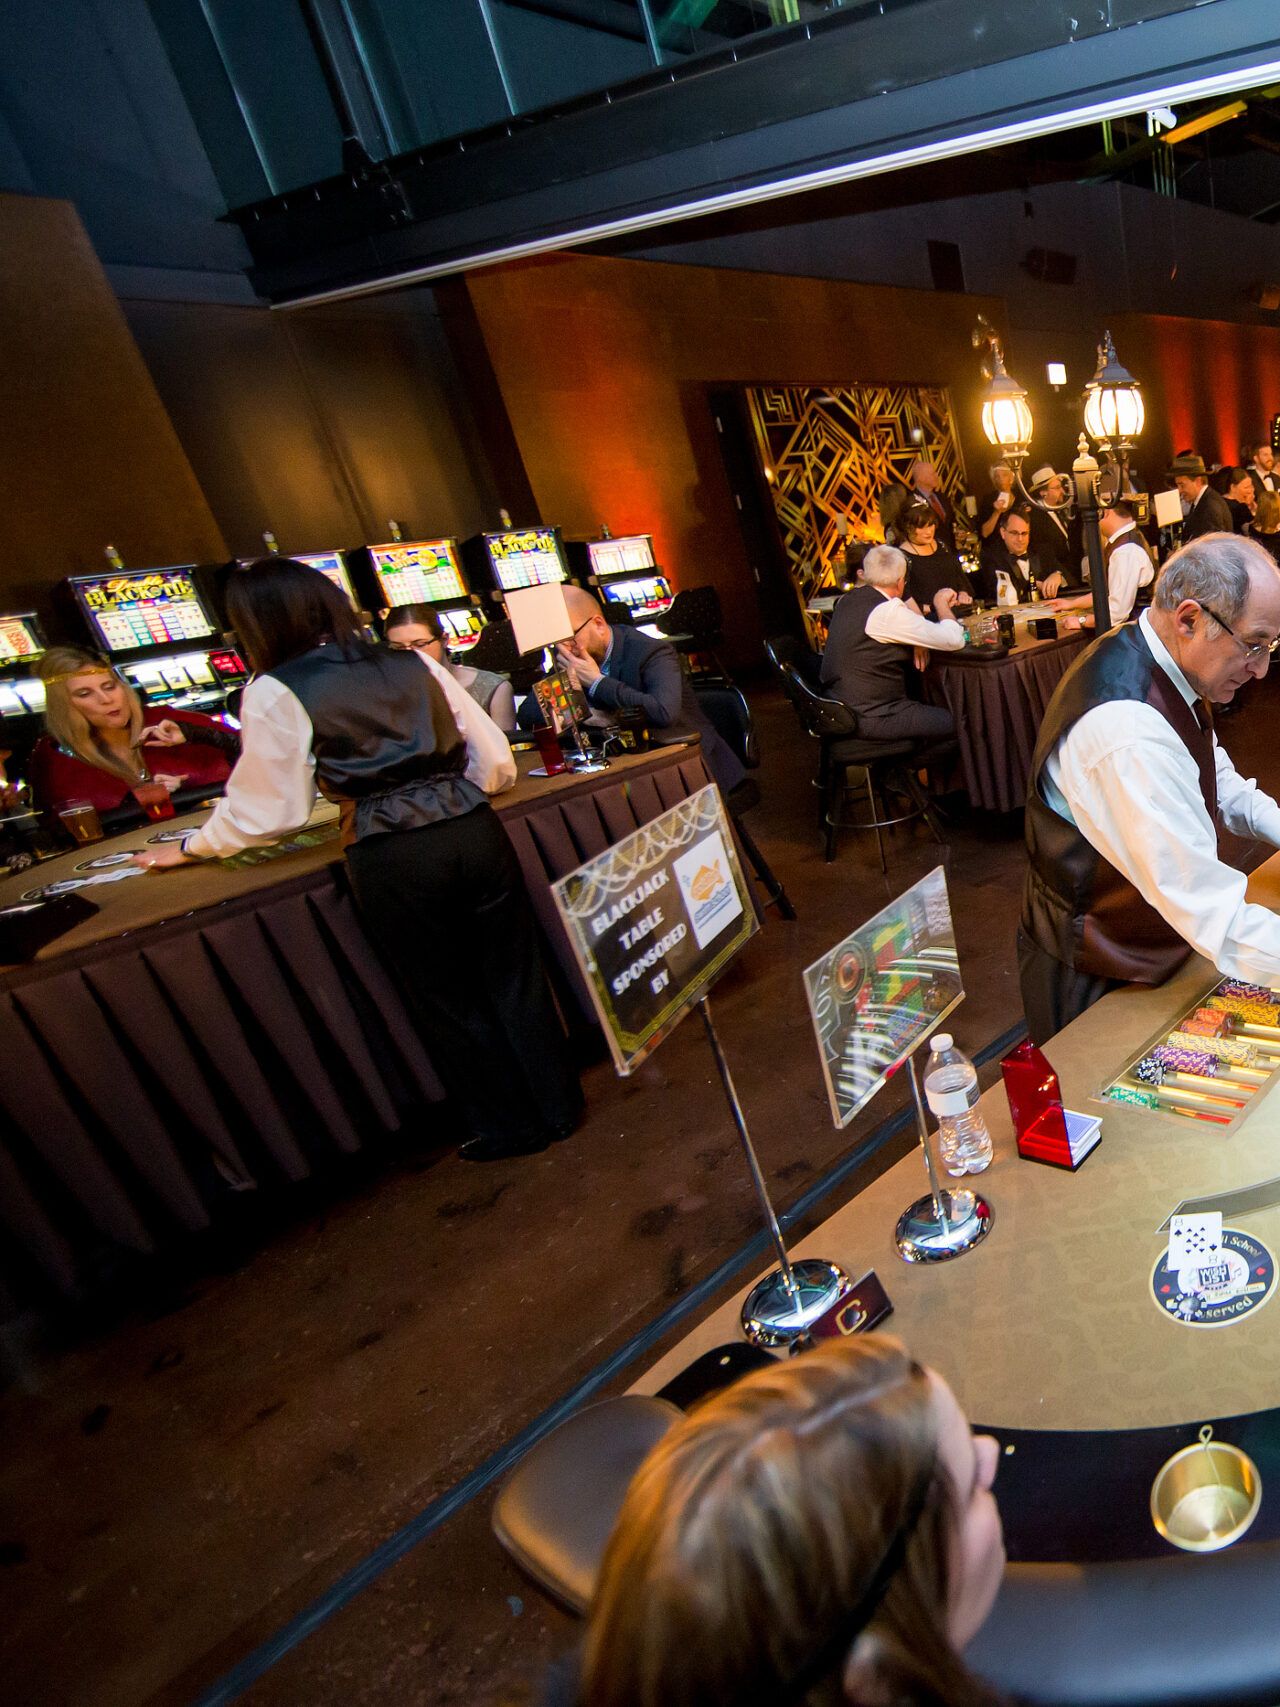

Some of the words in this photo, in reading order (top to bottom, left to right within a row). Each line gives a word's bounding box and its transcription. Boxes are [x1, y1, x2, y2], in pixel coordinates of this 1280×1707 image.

[84, 585, 152, 607] BLACK
[163, 580, 194, 597] TIE
[591, 868, 670, 936] BLACKJACK
[618, 907, 665, 950] TABLE
[612, 923, 688, 996] SPONSORED
[651, 969, 671, 995] BY
[1229, 1235, 1262, 1258] School
[1200, 1272, 1227, 1286] LIST
[1202, 1295, 1254, 1319] served
